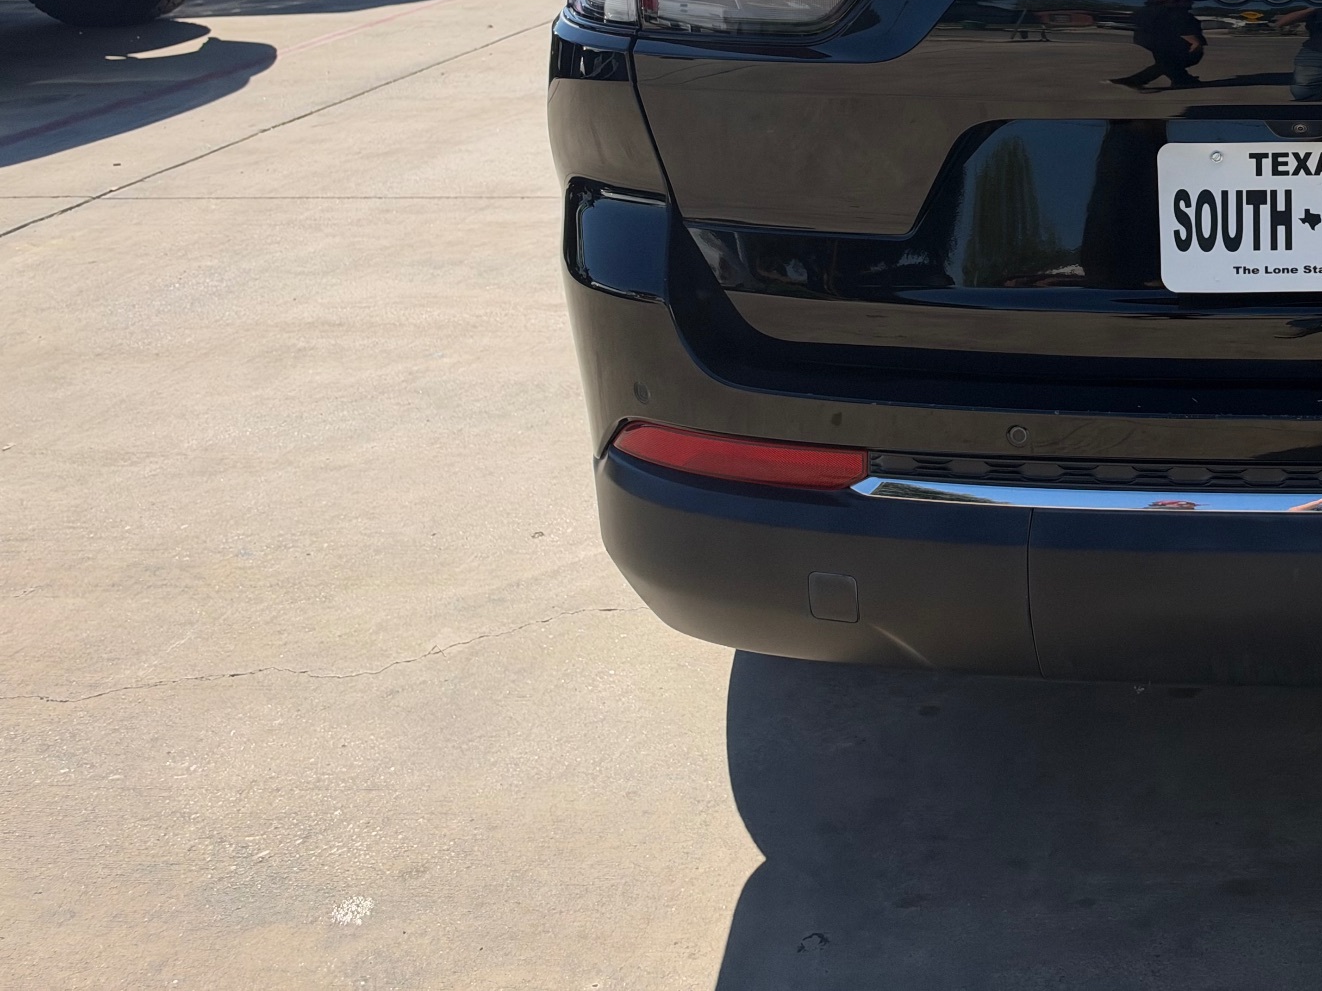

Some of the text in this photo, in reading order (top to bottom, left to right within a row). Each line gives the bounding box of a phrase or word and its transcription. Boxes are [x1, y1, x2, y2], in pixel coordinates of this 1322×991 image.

[1173, 188, 1293, 253] SOUTH
[1232, 265, 1260, 275] The
[1264, 265, 1299, 275] Lone
